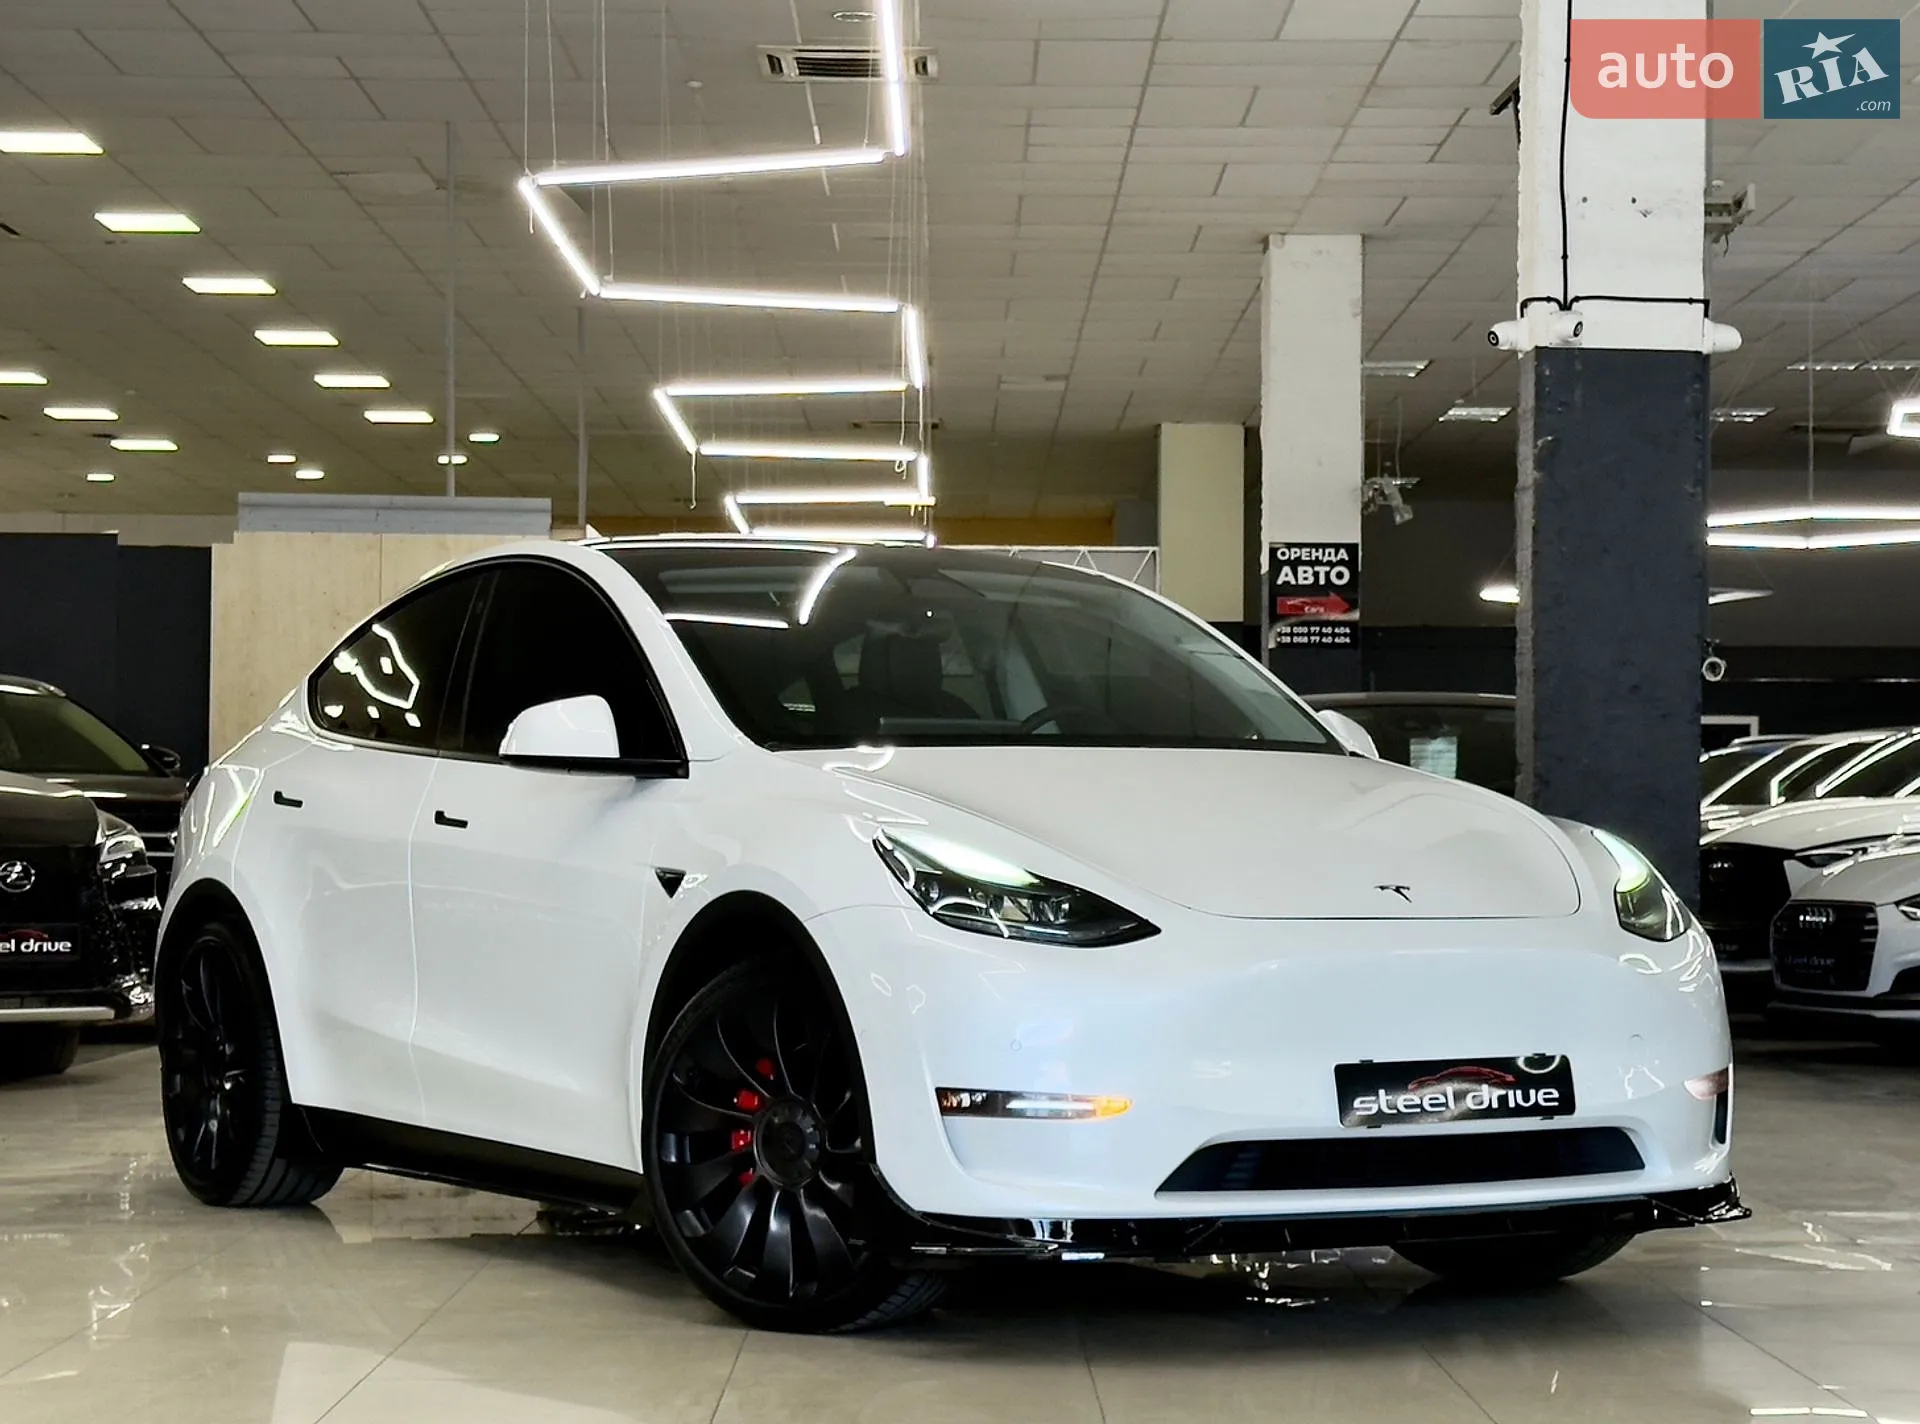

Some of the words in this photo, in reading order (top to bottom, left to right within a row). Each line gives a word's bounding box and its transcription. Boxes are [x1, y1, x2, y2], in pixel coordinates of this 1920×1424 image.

[1277, 547, 1349, 563] ОРЕНДА
[1276, 565, 1351, 586] АВТО
[1309, 626, 1320, 634] 77
[1309, 635, 1320, 644] 77
[20, 938, 72, 953] drive
[1353, 1085, 1455, 1116] steel
[1465, 1083, 1560, 1111] drive
